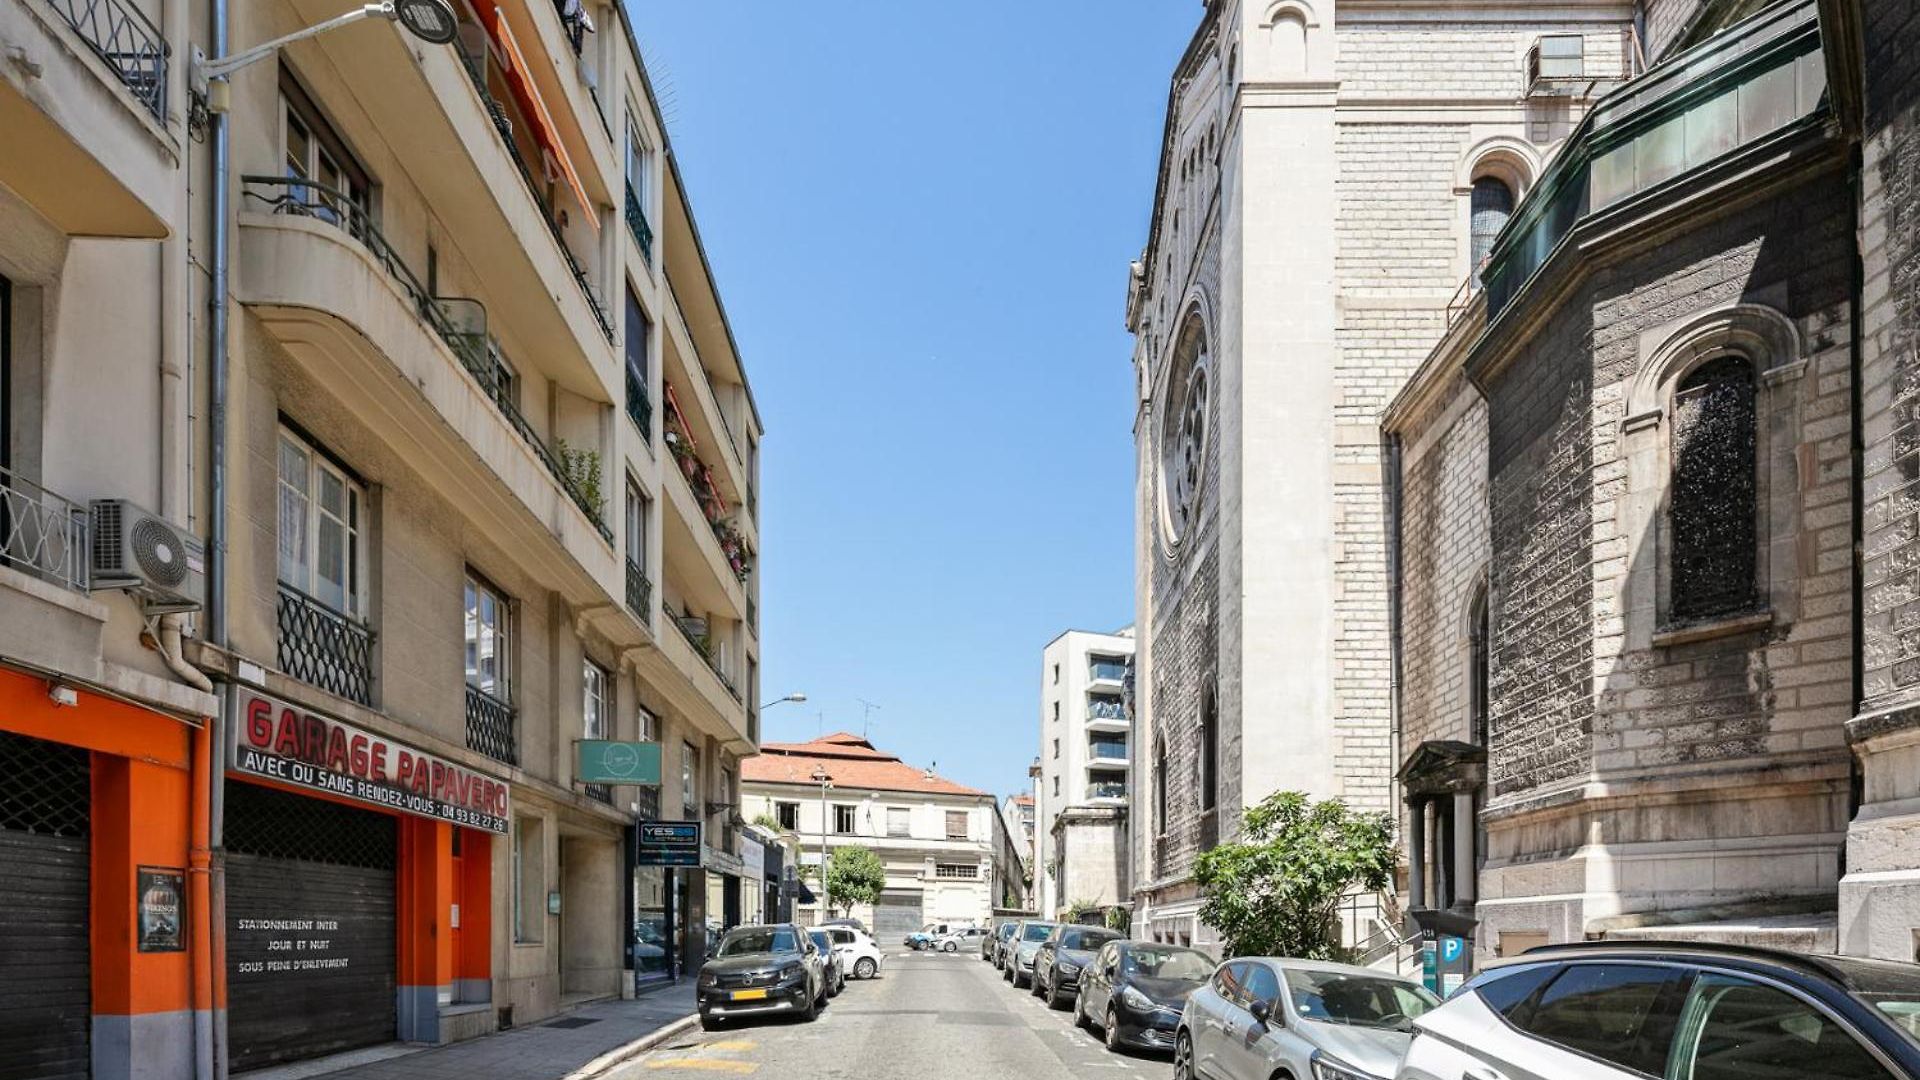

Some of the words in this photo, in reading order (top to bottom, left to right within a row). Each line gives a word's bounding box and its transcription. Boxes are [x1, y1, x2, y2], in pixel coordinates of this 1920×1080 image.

[247, 698, 389, 782] GARAGE
[398, 750, 509, 817] PAPAVERO
[244, 751, 286, 778] AVEC
[292, 763, 313, 783] OU
[317, 771, 354, 794] SANS
[357, 780, 434, 814] RENDEZ-VOUS
[442, 804, 454, 819] 04
[456, 808, 468, 822] 93
[238, 919, 313, 930] STATIONNEMENT
[316, 920, 338, 930] INTER
[267, 940, 292, 950] JOUR
[296, 940, 306, 950] ET
[1446, 940, 1457, 957] P
[238, 962, 264, 973] SOUS
[267, 961, 291, 971] PEINE
